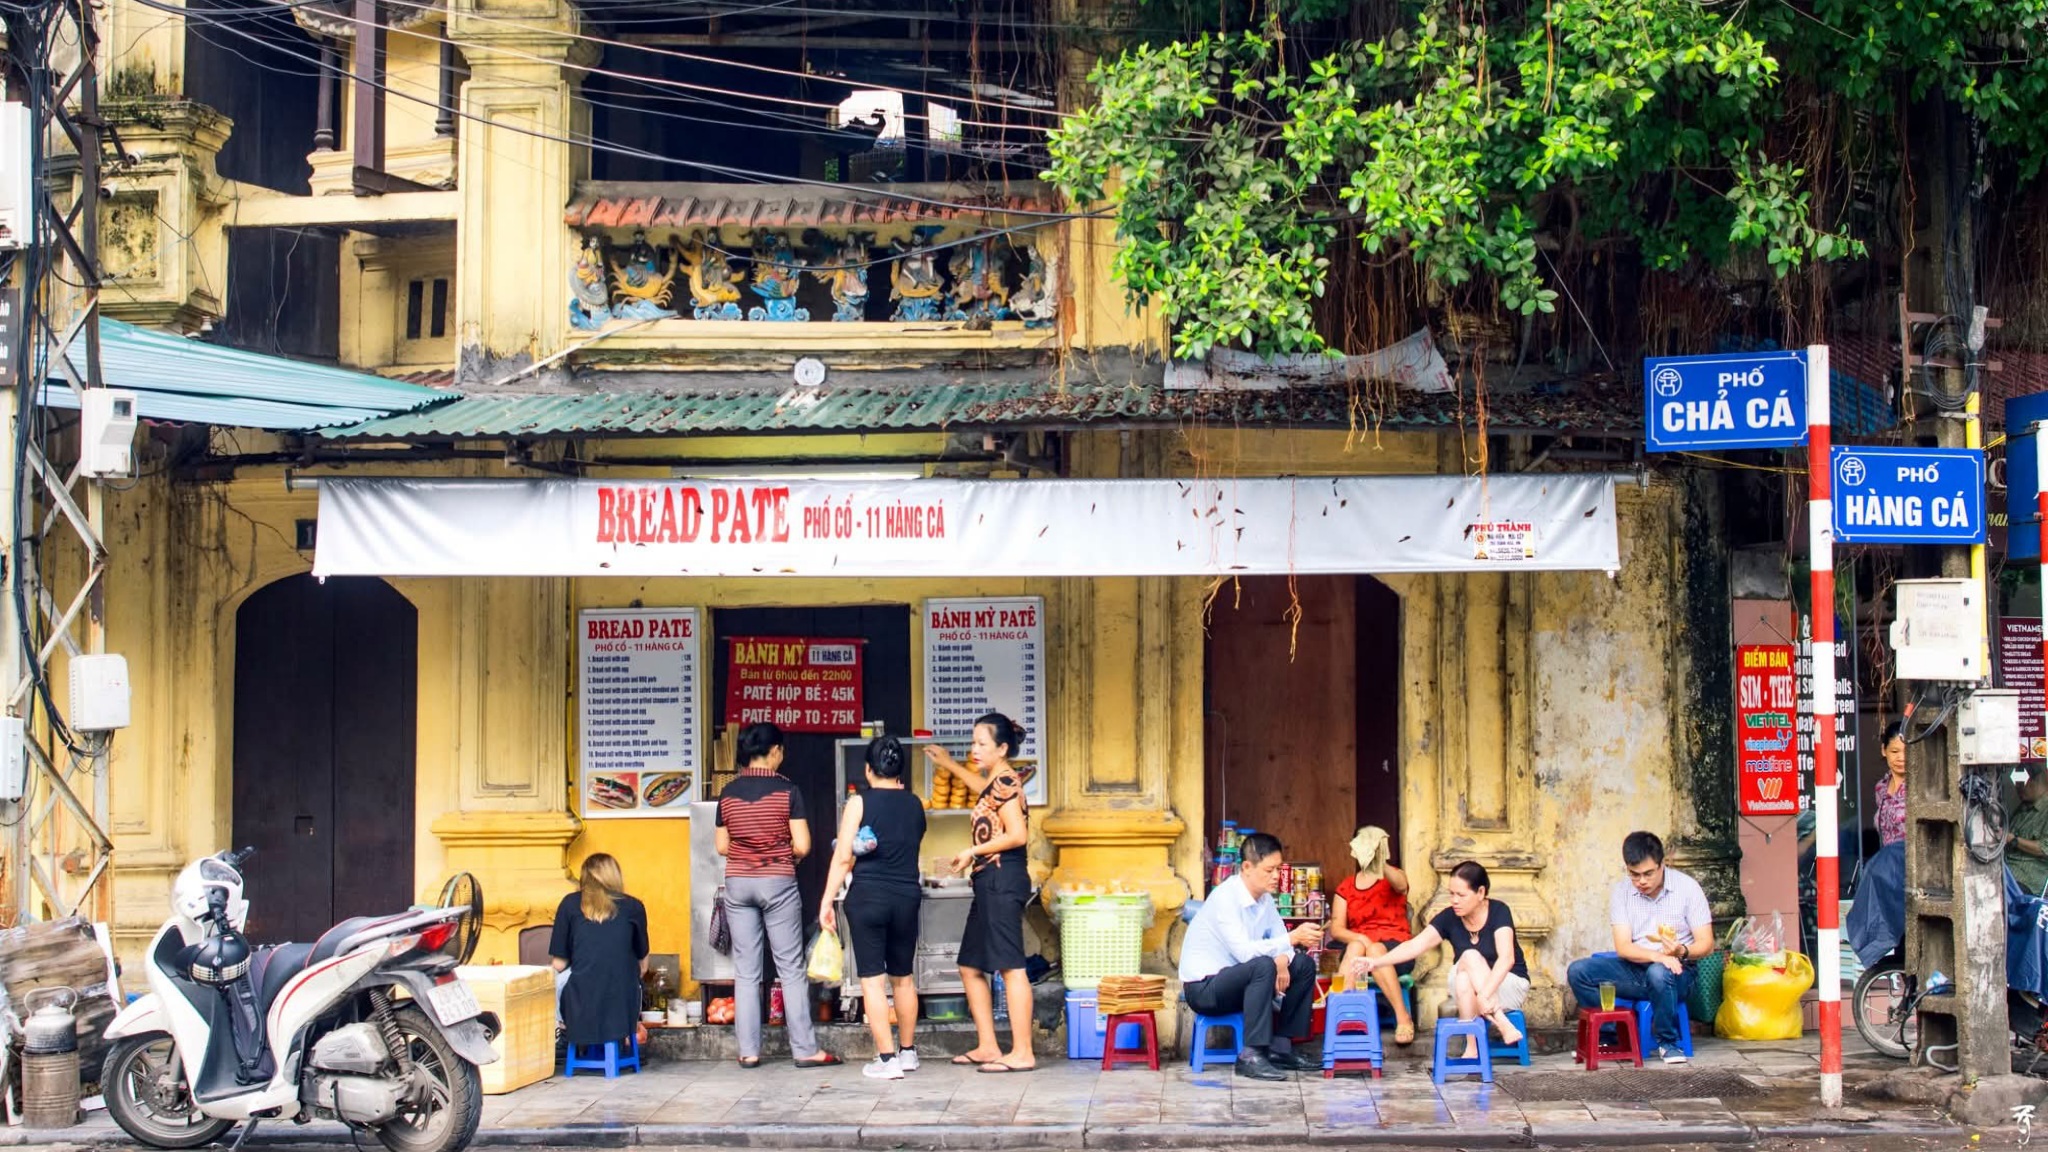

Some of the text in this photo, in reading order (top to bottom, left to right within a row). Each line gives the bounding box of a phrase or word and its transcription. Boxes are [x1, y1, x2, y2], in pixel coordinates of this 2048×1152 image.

[1718, 365, 1765, 388] PHỐ
[1662, 389, 1796, 432] CHẢ CÁ
[1897, 462, 1940, 483] PHỐ
[597, 487, 701, 543] BREAD
[710, 487, 789, 543] PATE
[803, 494, 830, 539] PHỐ
[866, 506, 880, 538] 11
[887, 499, 923, 539] HÀNG
[927, 499, 945, 538] CÁ
[1846, 488, 1969, 528] HÀNG CÁ
[931, 605, 1036, 629] BÁNH MỲ PATÊ
[588, 619, 692, 639] BREAD PATE
[940, 630, 958, 640] PHỐ
[980, 632, 988, 640] 11
[989, 630, 1015, 640] HÀNG
[595, 641, 613, 652] PHỐ
[634, 643, 643, 651] 11
[645, 641, 670, 651] HÀNG
[735, 637, 853, 666] BÁNH MỲ 11 HÀNG CÁ
[1744, 646, 1767, 667] ĐIỂM
[1769, 648, 1788, 667] BÁN
[741, 668, 760, 679] Bán
[801, 669, 819, 680] đến
[823, 670, 852, 680] 22h00
[743, 683, 773, 700] PATÊ
[776, 683, 801, 704] HỘP
[805, 684, 821, 701] BÉ
[831, 687, 855, 701] 45K
[1740, 675, 1762, 708] SIM
[1769, 665, 1794, 708] THẺ
[742, 706, 771, 723] PATÊ
[775, 706, 801, 727] HỘP
[805, 710, 820, 724] TO
[831, 710, 855, 724] 75K
[1744, 711, 1792, 728] VIETTEL
[1745, 755, 1792, 772] mobifone
